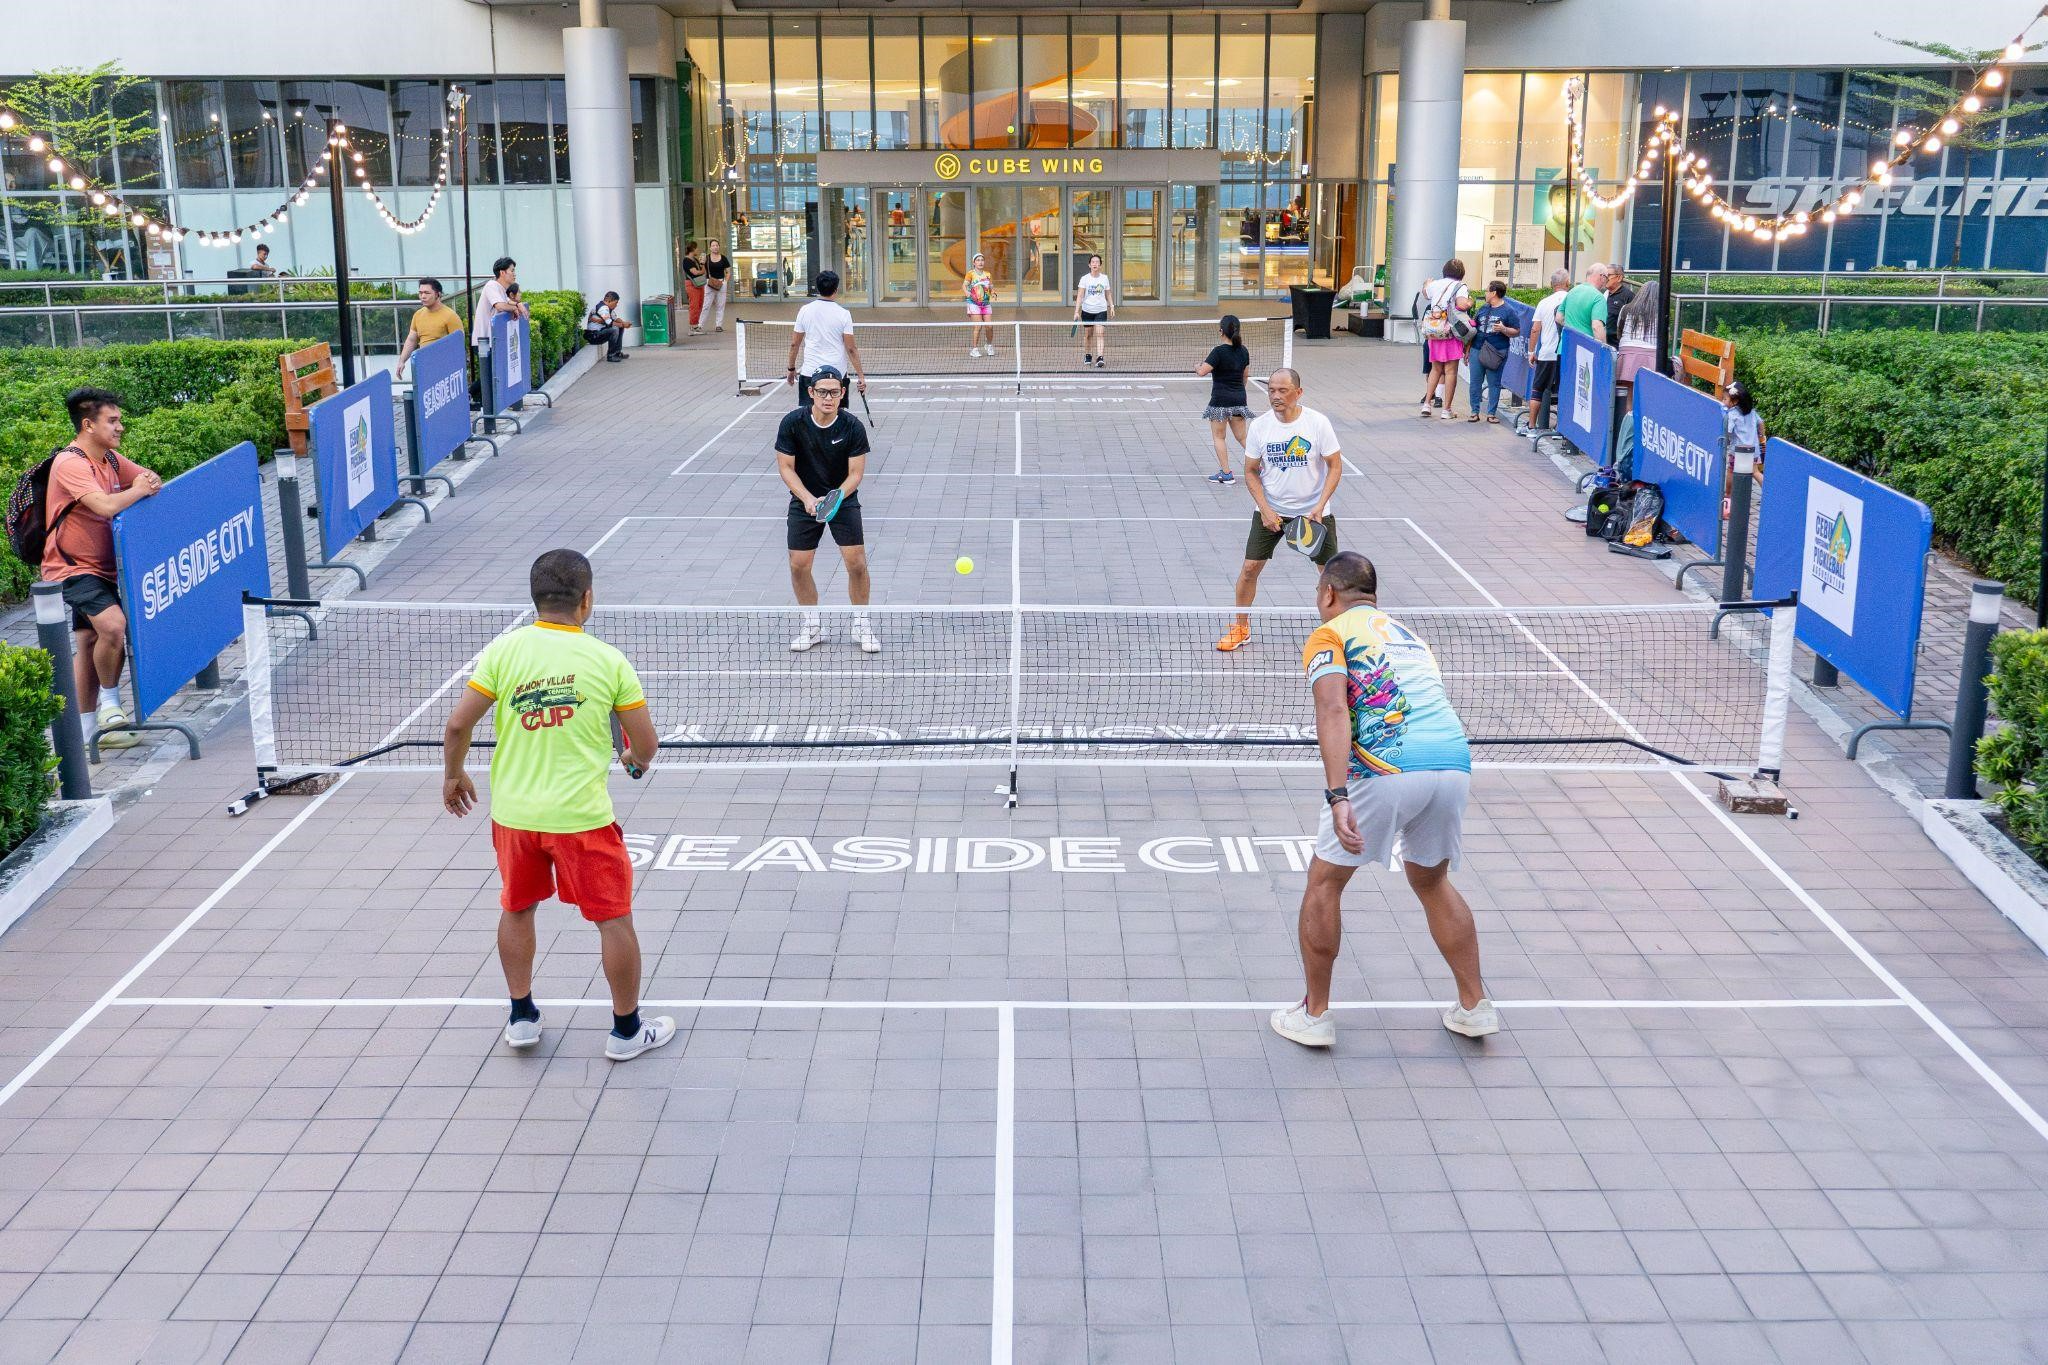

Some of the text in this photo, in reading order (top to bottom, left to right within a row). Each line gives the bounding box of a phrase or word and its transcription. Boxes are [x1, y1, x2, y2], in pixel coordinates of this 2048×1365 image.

[969, 158, 1103, 174] CUBE WING
[423, 367, 464, 419] SEASIDE CITY
[1266, 443, 1287, 452] CEBU
[1641, 415, 1714, 487] SEASIDE CITY
[1815, 514, 1834, 540] CEBU
[142, 505, 254, 620] SEASIDE CITY
[546, 674, 575, 686] VILLAGE
[521, 706, 574, 731] CUP
[1138, 836, 1404, 873] CIT
[643, 1028, 657, 1044] N
